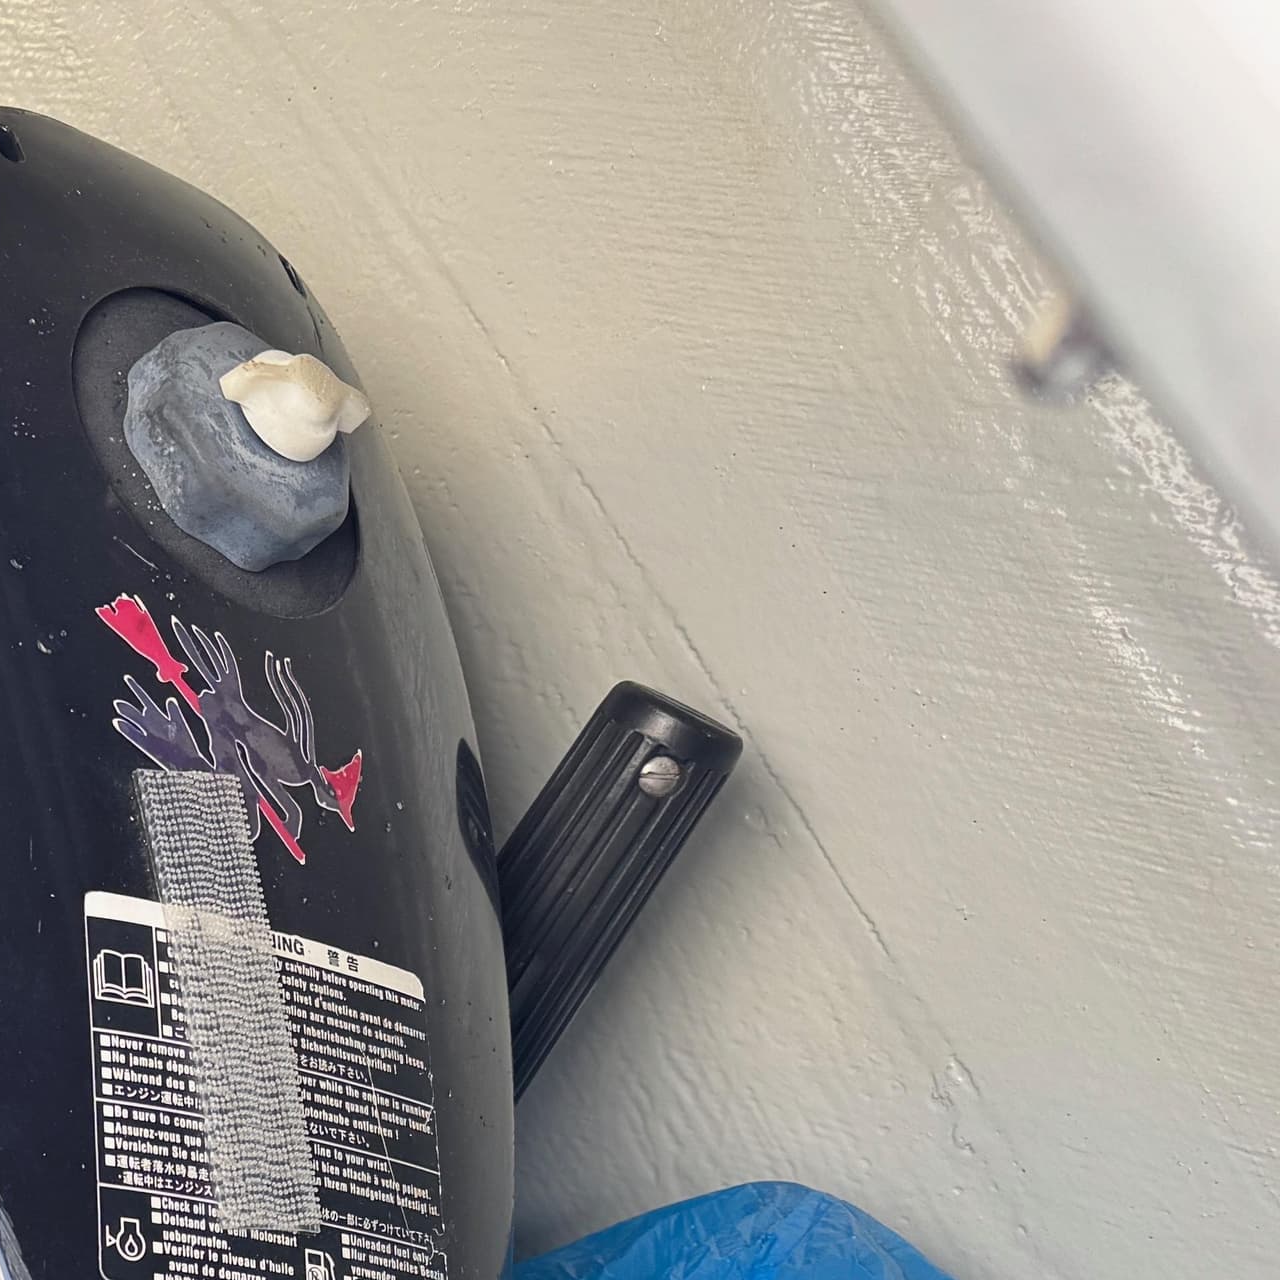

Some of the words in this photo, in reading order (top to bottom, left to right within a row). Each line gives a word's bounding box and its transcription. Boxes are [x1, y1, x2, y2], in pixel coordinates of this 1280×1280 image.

[322, 970, 347, 987] before
[349, 980, 383, 1001] operating
[385, 990, 399, 1004] this
[310, 1012, 325, 1025] aux
[327, 1016, 361, 1034] mesures
[362, 1025, 373, 1037] de
[360, 1011, 381, 1026] avant
[382, 1017, 392, 1030] de
[303, 1024, 367, 1051] Inbetriebnahme
[111, 1035, 143, 1051] Never
[146, 1042, 186, 1059] remove
[297, 1075, 317, 1088] over
[319, 1078, 344, 1095] while
[346, 1085, 360, 1098] the
[362, 1090, 390, 1107] engine
[392, 1098, 400, 1110] is
[112, 1050, 126, 1064] Ne
[129, 1053, 164, 1070] jamais
[314, 1091, 342, 1107] moteur
[345, 1100, 369, 1116] quand
[381, 1110, 407, 1129] moteur
[112, 1067, 162, 1087] Während
[166, 1076, 185, 1091] des
[305, 1108, 350, 1127] otorhaube
[352, 1118, 393, 1139] entfernen
[114, 1105, 129, 1119] Be
[132, 1110, 156, 1123] sure
[159, 1112, 171, 1125] to
[174, 1116, 204, 1132] conne
[314, 1144, 331, 1158] line
[334, 1149, 343, 1161] to
[345, 1153, 364, 1167] your
[367, 1157, 390, 1173] wrist.
[115, 1121, 181, 1144] Assurez-vous
[183, 1134, 202, 1148] que
[322, 1161, 340, 1176] bien
[115, 1137, 169, 1157] Versichern
[171, 1145, 188, 1160] Sie
[350, 1182, 395, 1205] Handgelenk
[162, 1198, 190, 1213] Check
[193, 1203, 205, 1216] oil
[251, 1229, 297, 1247] Motorstart
[350, 1234, 391, 1254] Unleaded
[394, 1244, 410, 1259] fuel
[169, 1260, 199, 1275] avant
[202, 1264, 214, 1277] de
[208, 1249, 218, 1263] le
[222, 1253, 256, 1269] niveau
[260, 1258, 295, 1276] d'huile
[369, 1253, 418, 1275] unverbleites
